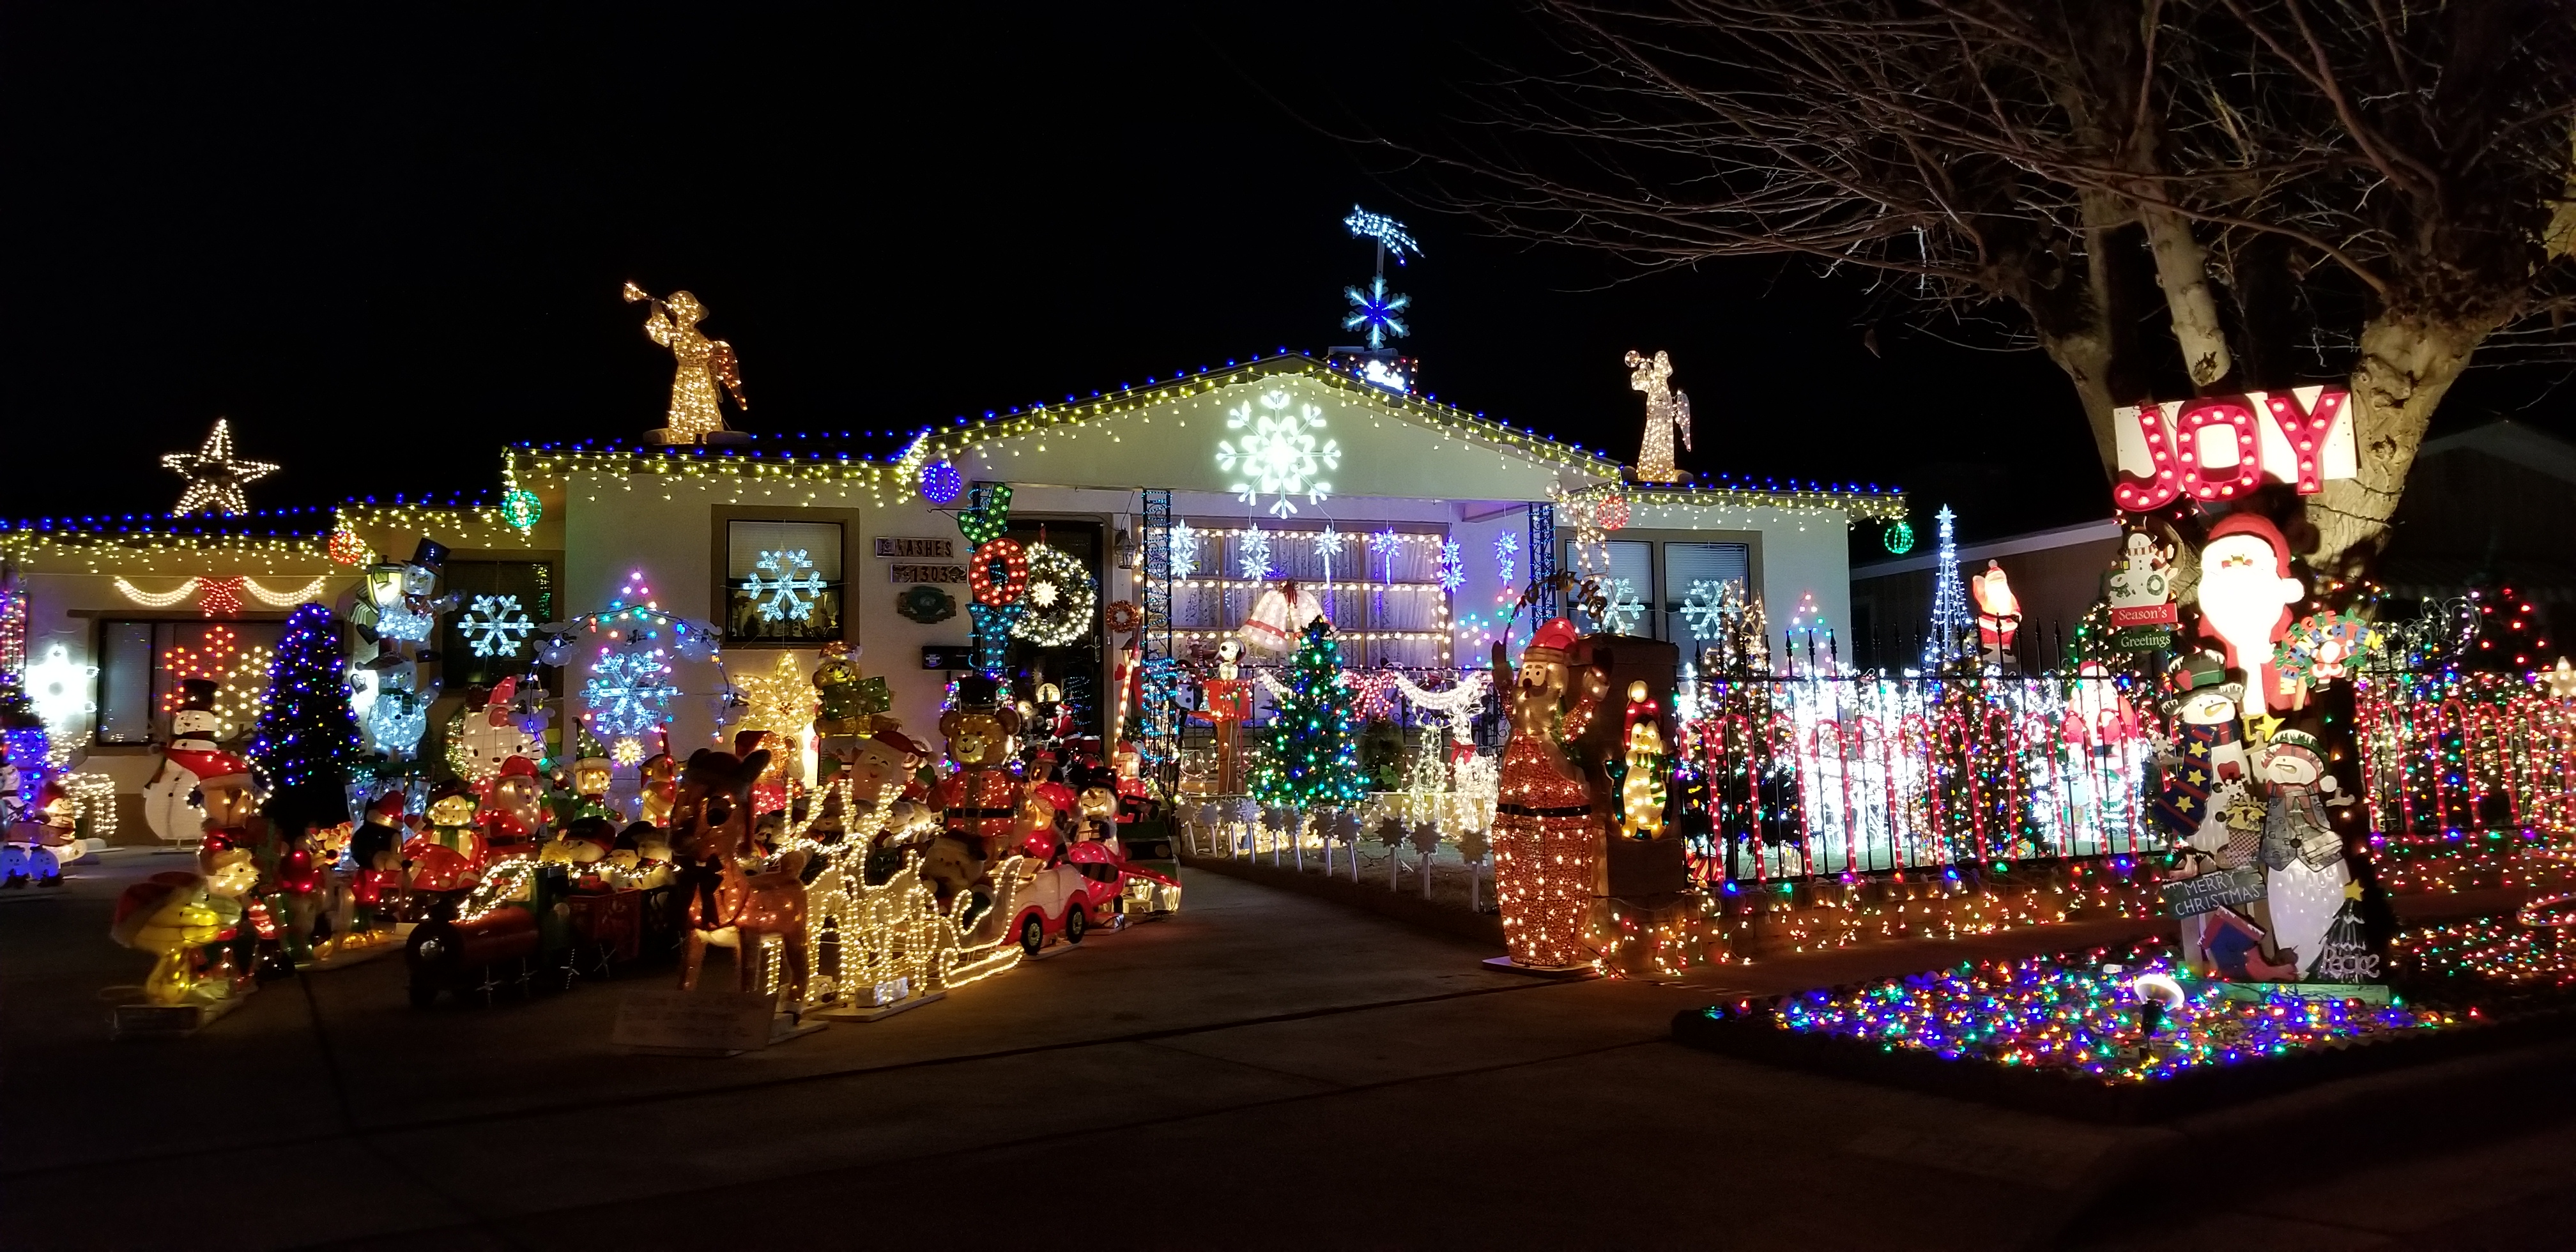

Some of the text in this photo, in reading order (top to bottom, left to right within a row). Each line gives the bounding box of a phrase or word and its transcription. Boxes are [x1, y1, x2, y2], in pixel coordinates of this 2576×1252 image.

[2113, 392, 2350, 512] JOY
[910, 567, 948, 583] 1303
[958, 484, 1029, 672] JOY
[2119, 606, 2168, 620] Season's
[2282, 610, 2336, 646] FROHE
[2120, 634, 2171, 648] Greetings
[2175, 883, 2260, 915] CHRISTMAS
[2184, 871, 2235, 896] MERRY
[2321, 944, 2380, 979] Peace
